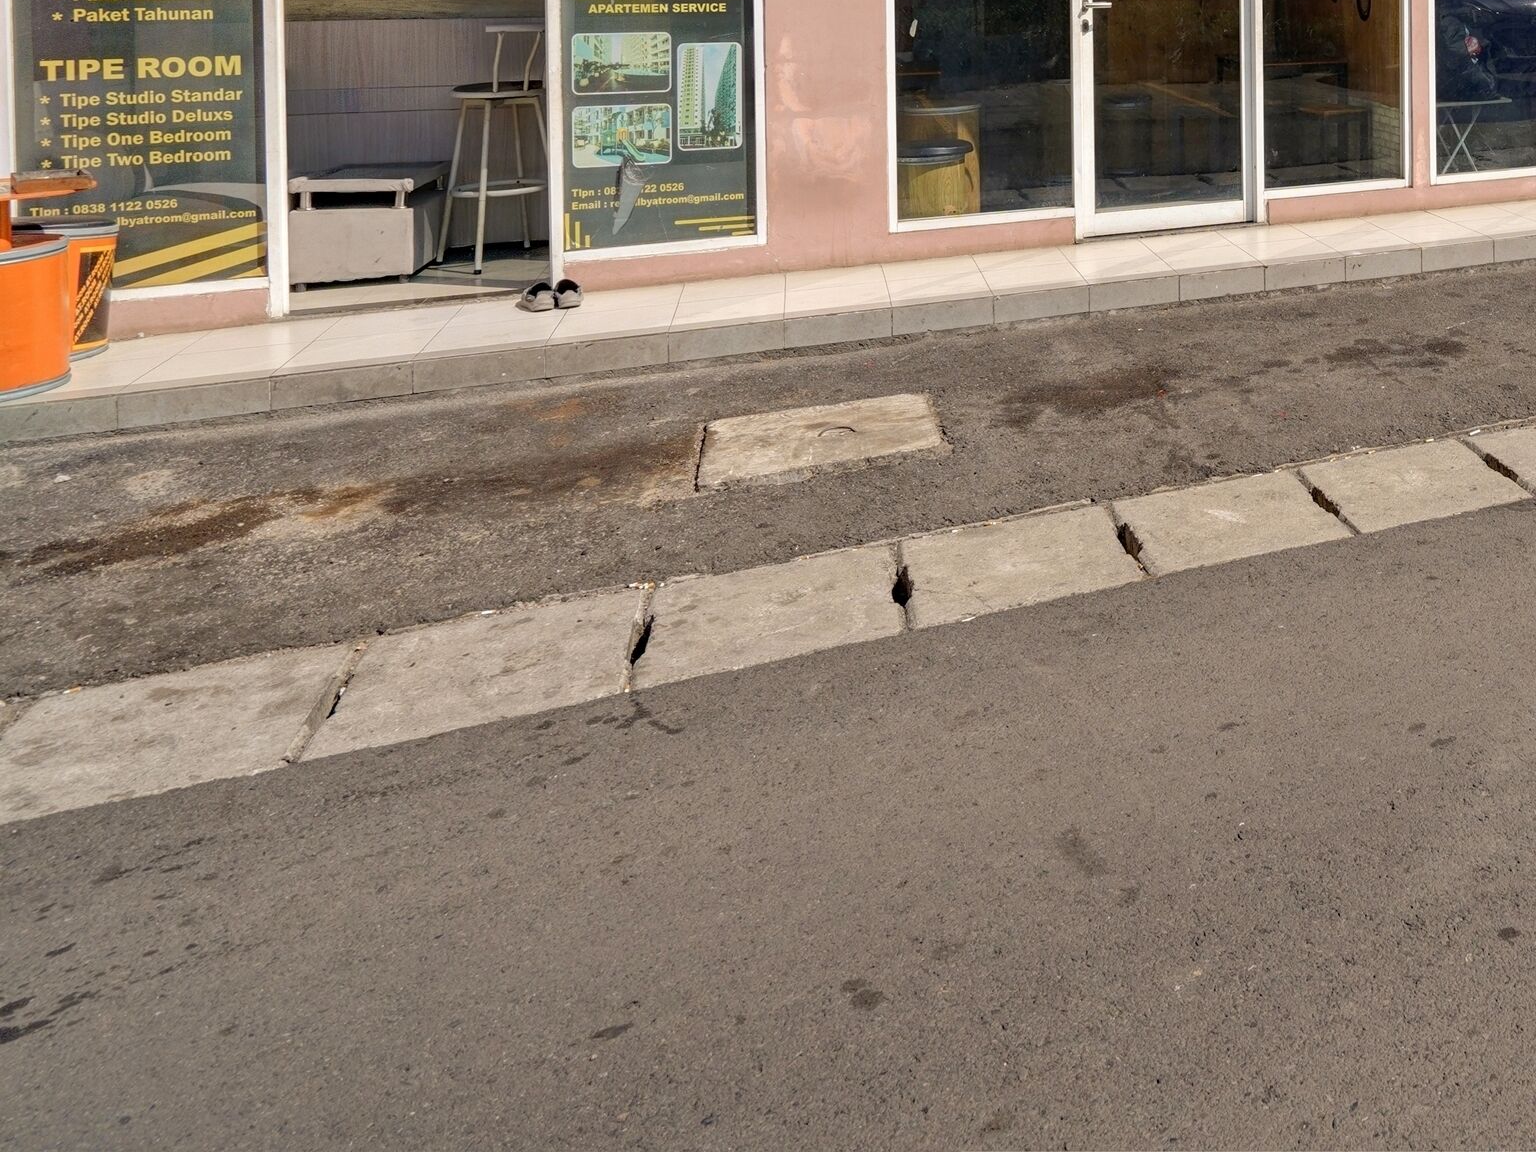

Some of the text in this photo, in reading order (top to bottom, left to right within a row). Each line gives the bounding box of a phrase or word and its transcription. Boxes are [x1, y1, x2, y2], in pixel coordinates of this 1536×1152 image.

[73, 8, 214, 22] Paket Tahunan
[588, 3, 727, 14] APARTEMEN SERVICE
[40, 55, 242, 82] TIPE ROOM
[60, 88, 243, 109] Tipe Studio Standar
[60, 109, 234, 130] Tipe Studio Deluxs
[61, 130, 232, 150] Tipe One Bedroom
[61, 150, 232, 170] Tipe Two Bedroom
[659, 183, 685, 192] 0526
[73, 204, 106, 215] 0838
[110, 201, 142, 213] 1122
[146, 199, 178, 210] 0526
[571, 201, 601, 211] Email
